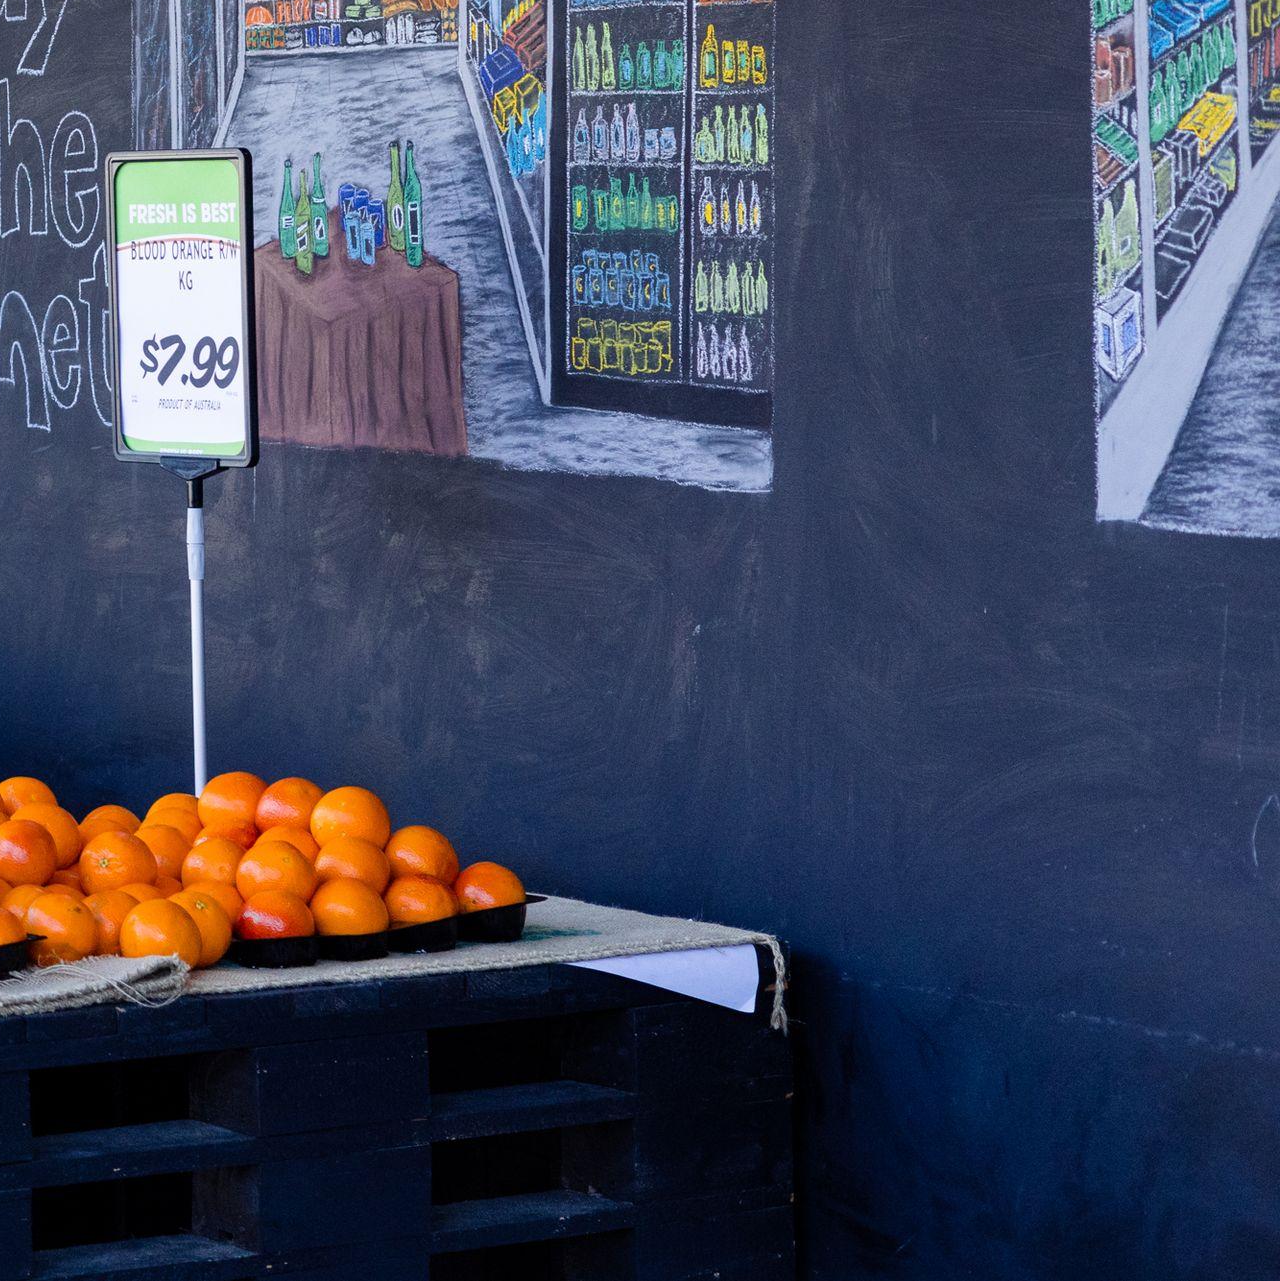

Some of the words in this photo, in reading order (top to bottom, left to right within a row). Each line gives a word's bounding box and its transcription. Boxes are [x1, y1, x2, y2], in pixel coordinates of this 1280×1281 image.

[128, 203, 178, 224] FRESH
[182, 203, 196, 224] IS
[201, 202, 237, 224] BEST
[131, 241, 166, 260] BLOOD
[172, 240, 214, 260] ORANGE
[178, 271, 194, 290] KG
[139, 333, 240, 389] $7.99
[159, 398, 183, 410] PRODUCT
[185, 399, 193, 410] OF
[193, 399, 221, 411] AUSTRALIA
